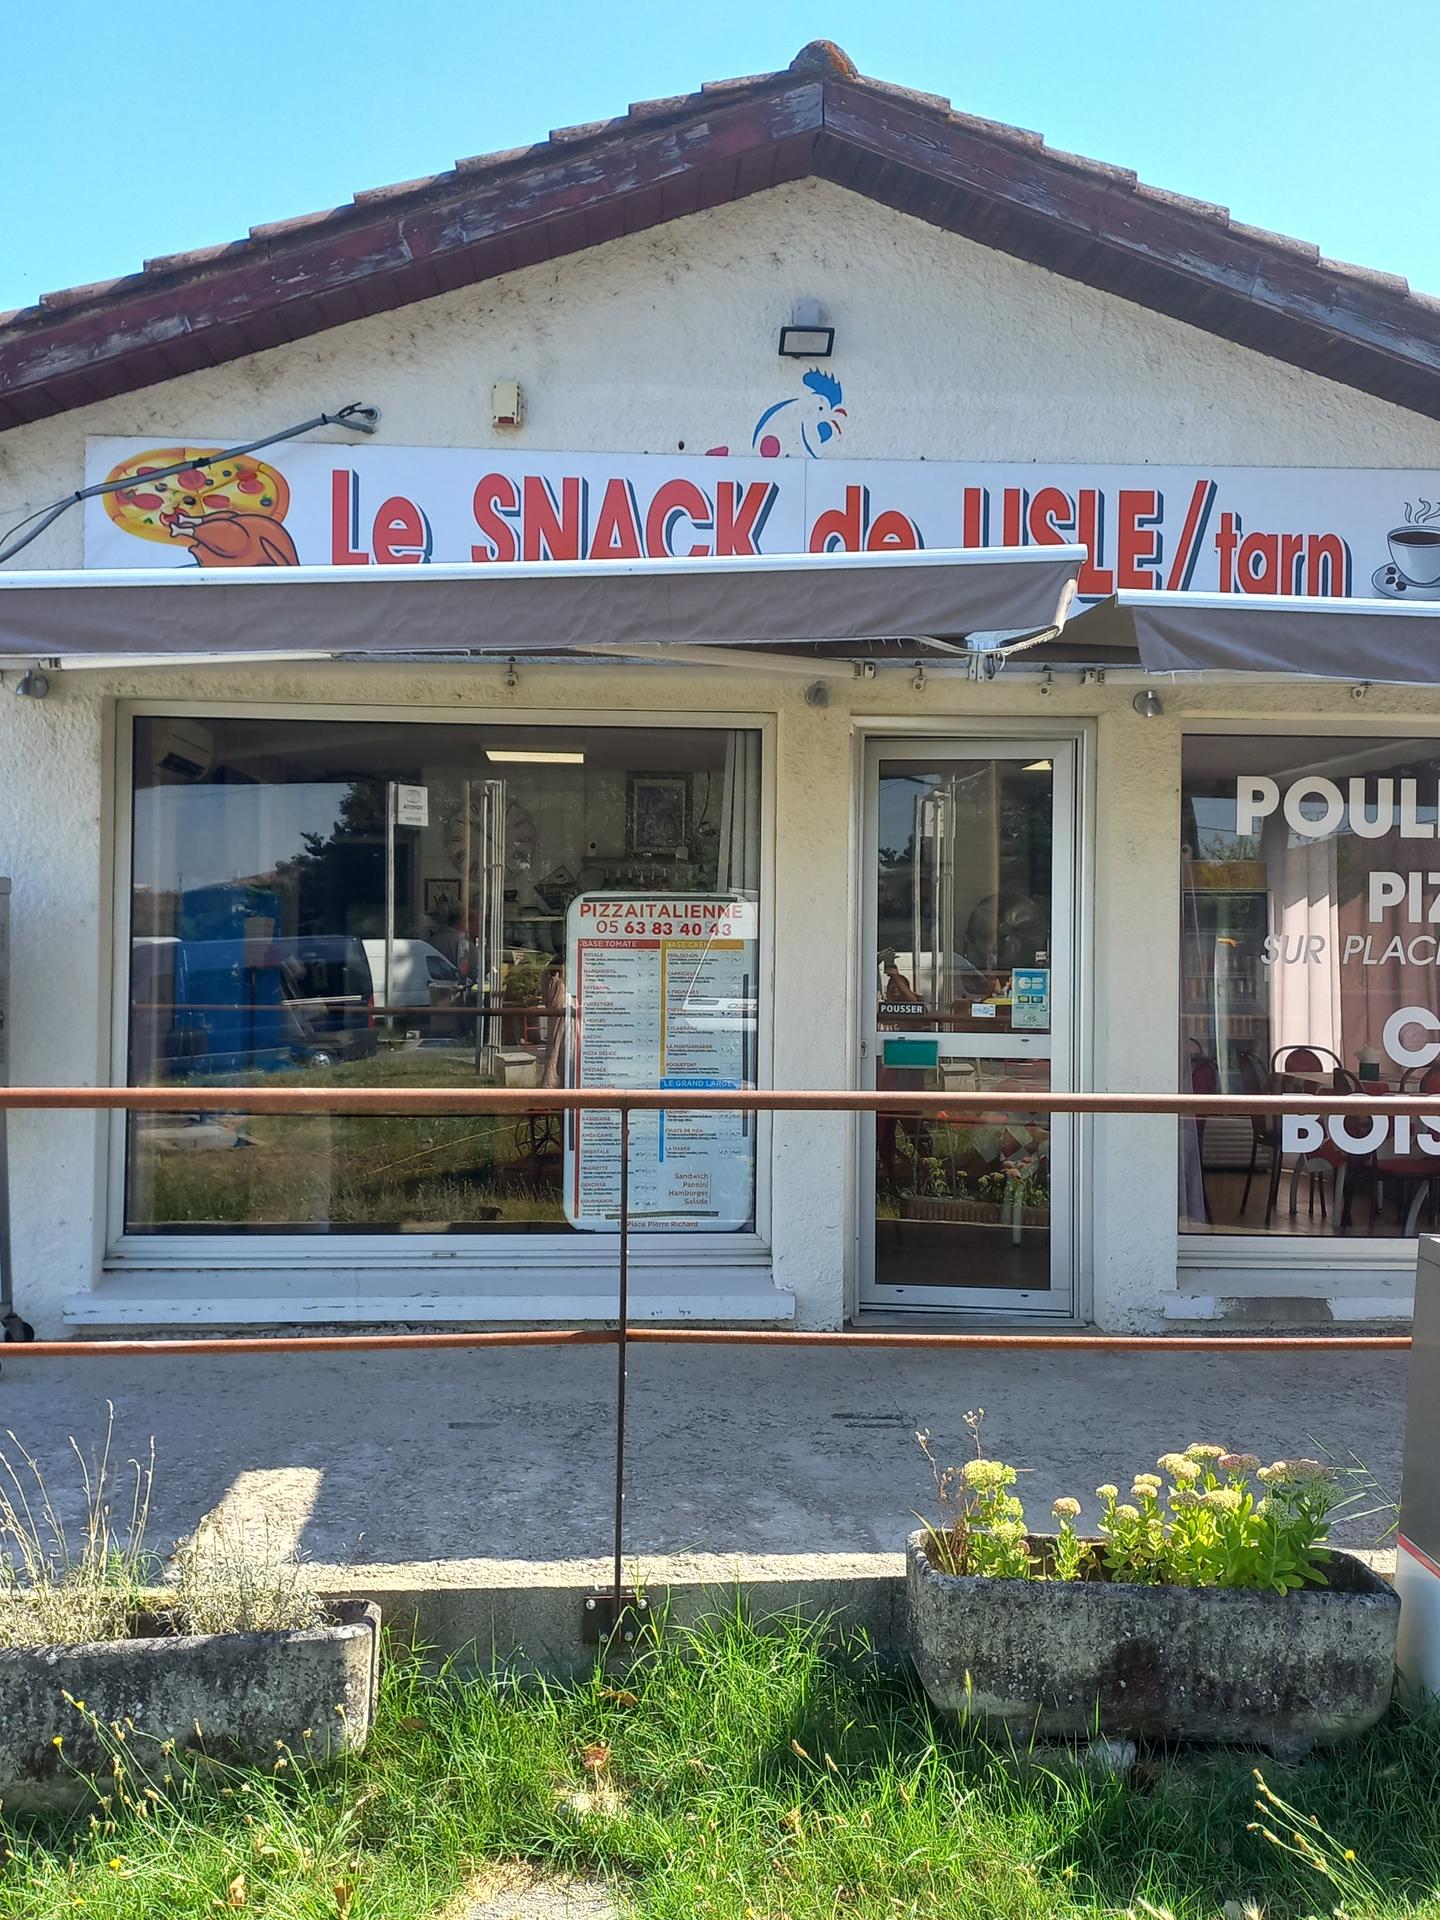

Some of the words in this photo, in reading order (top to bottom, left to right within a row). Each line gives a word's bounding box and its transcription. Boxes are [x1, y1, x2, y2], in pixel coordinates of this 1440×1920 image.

[331, 468, 433, 565] Le
[471, 473, 779, 563] SNACK
[1236, 775, 1440, 838] POUL
[580, 903, 743, 919] PIZZAITALIENNE
[596, 920, 619, 934] 05
[624, 920, 646, 934] 63
[652, 921, 673, 935] 83
[680, 922, 702, 936] 40
[709, 922, 732, 936] 43
[1261, 935, 1326, 965] SUR
[1343, 935, 1440, 966] PLAC
[880, 1004, 923, 1013] POUSSER
[674, 1172, 708, 1180] Sandwich
[668, 1190, 708, 1198] Hamburger
[671, 1220, 698, 1228] Richard
